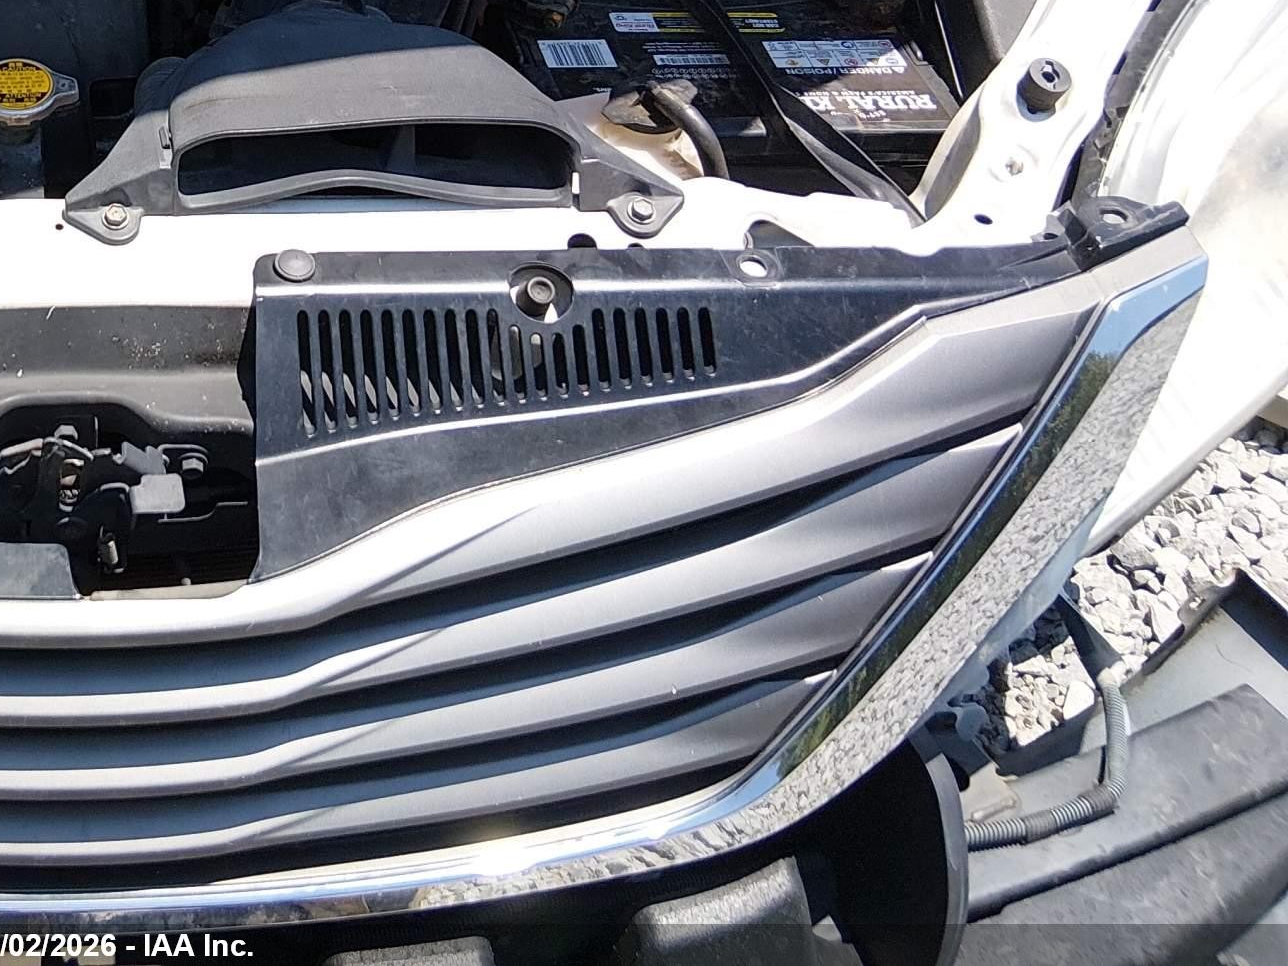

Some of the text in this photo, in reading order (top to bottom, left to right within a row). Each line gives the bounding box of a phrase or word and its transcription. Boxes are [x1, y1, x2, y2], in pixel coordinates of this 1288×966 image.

[784, 67, 833, 75] POISON
[839, 66, 893, 75] DANGER
[797, 95, 937, 111] RURAL KI
